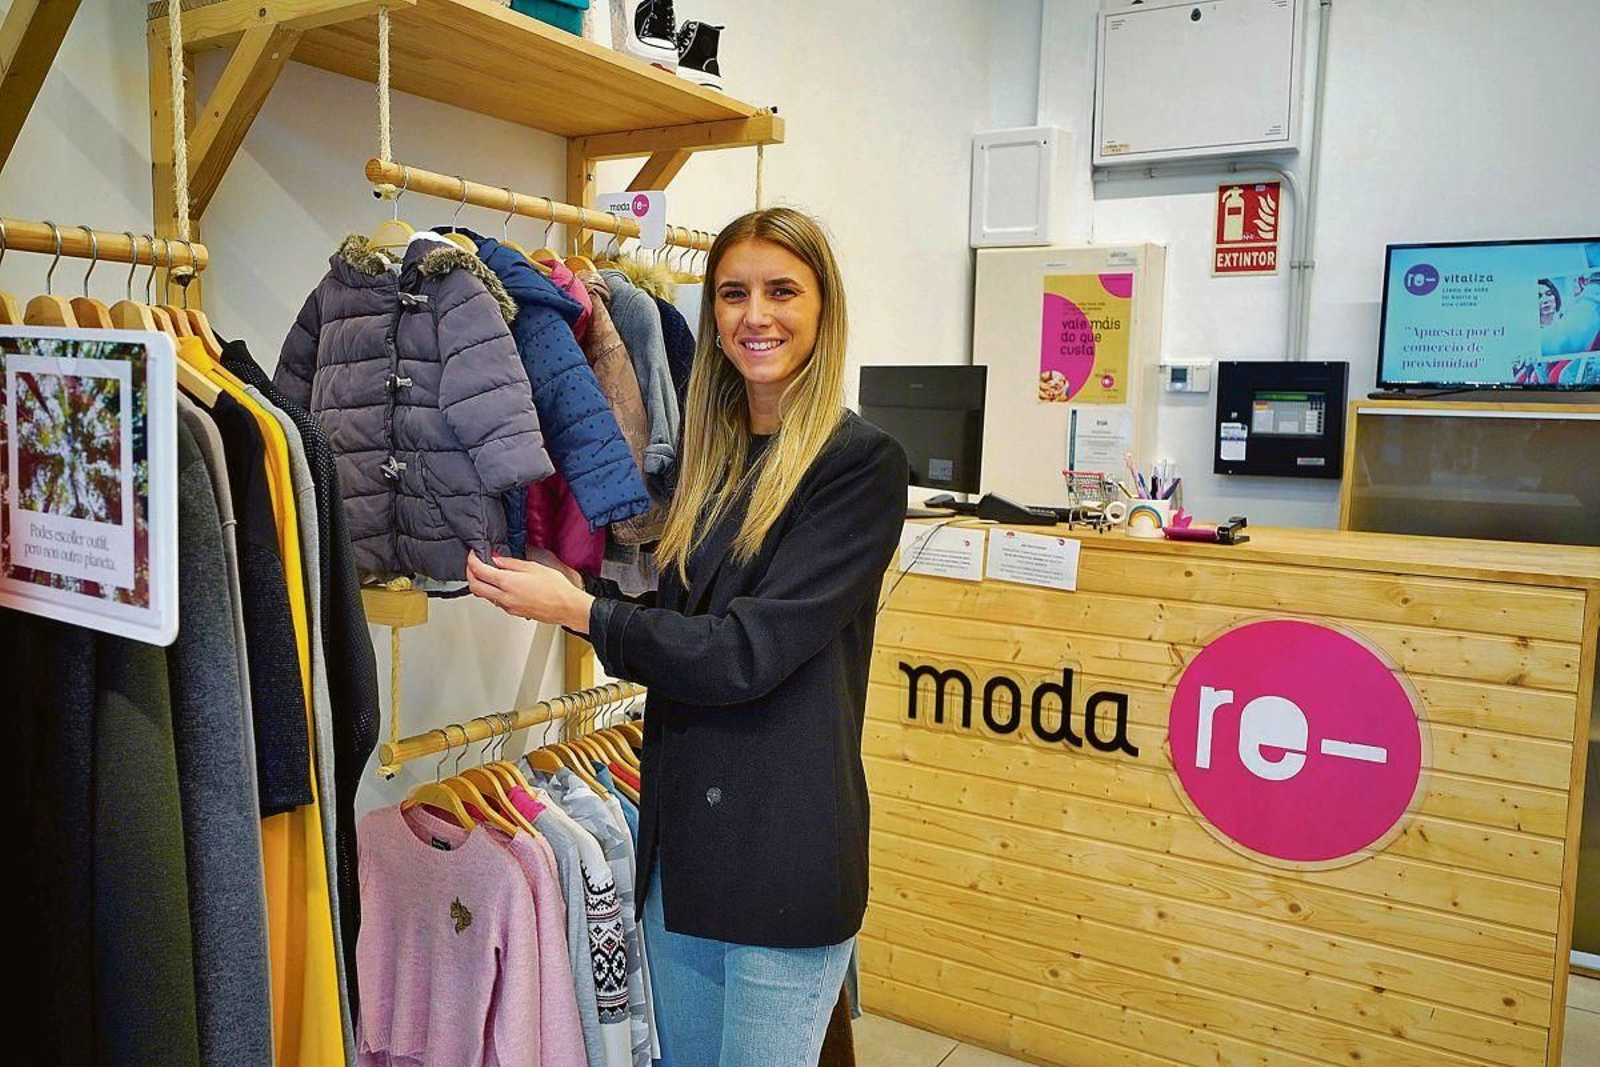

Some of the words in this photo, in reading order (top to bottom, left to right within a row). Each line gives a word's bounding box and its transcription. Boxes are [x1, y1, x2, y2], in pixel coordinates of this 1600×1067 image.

[609, 203, 630, 212] moda
[1216, 251, 1275, 268] EXTINTOR
[1444, 272, 1494, 284] vitaliza
[1062, 319, 1087, 330] vale
[1090, 316, 1121, 330] máis
[1060, 332, 1076, 342] do
[1079, 333, 1102, 344] que
[1465, 328, 1490, 340] por
[1492, 326, 1505, 337] el
[1060, 345, 1095, 356] custa
[1403, 342, 1464, 353] comercio
[1467, 342, 1483, 353] de
[898, 661, 1139, 757] moda
